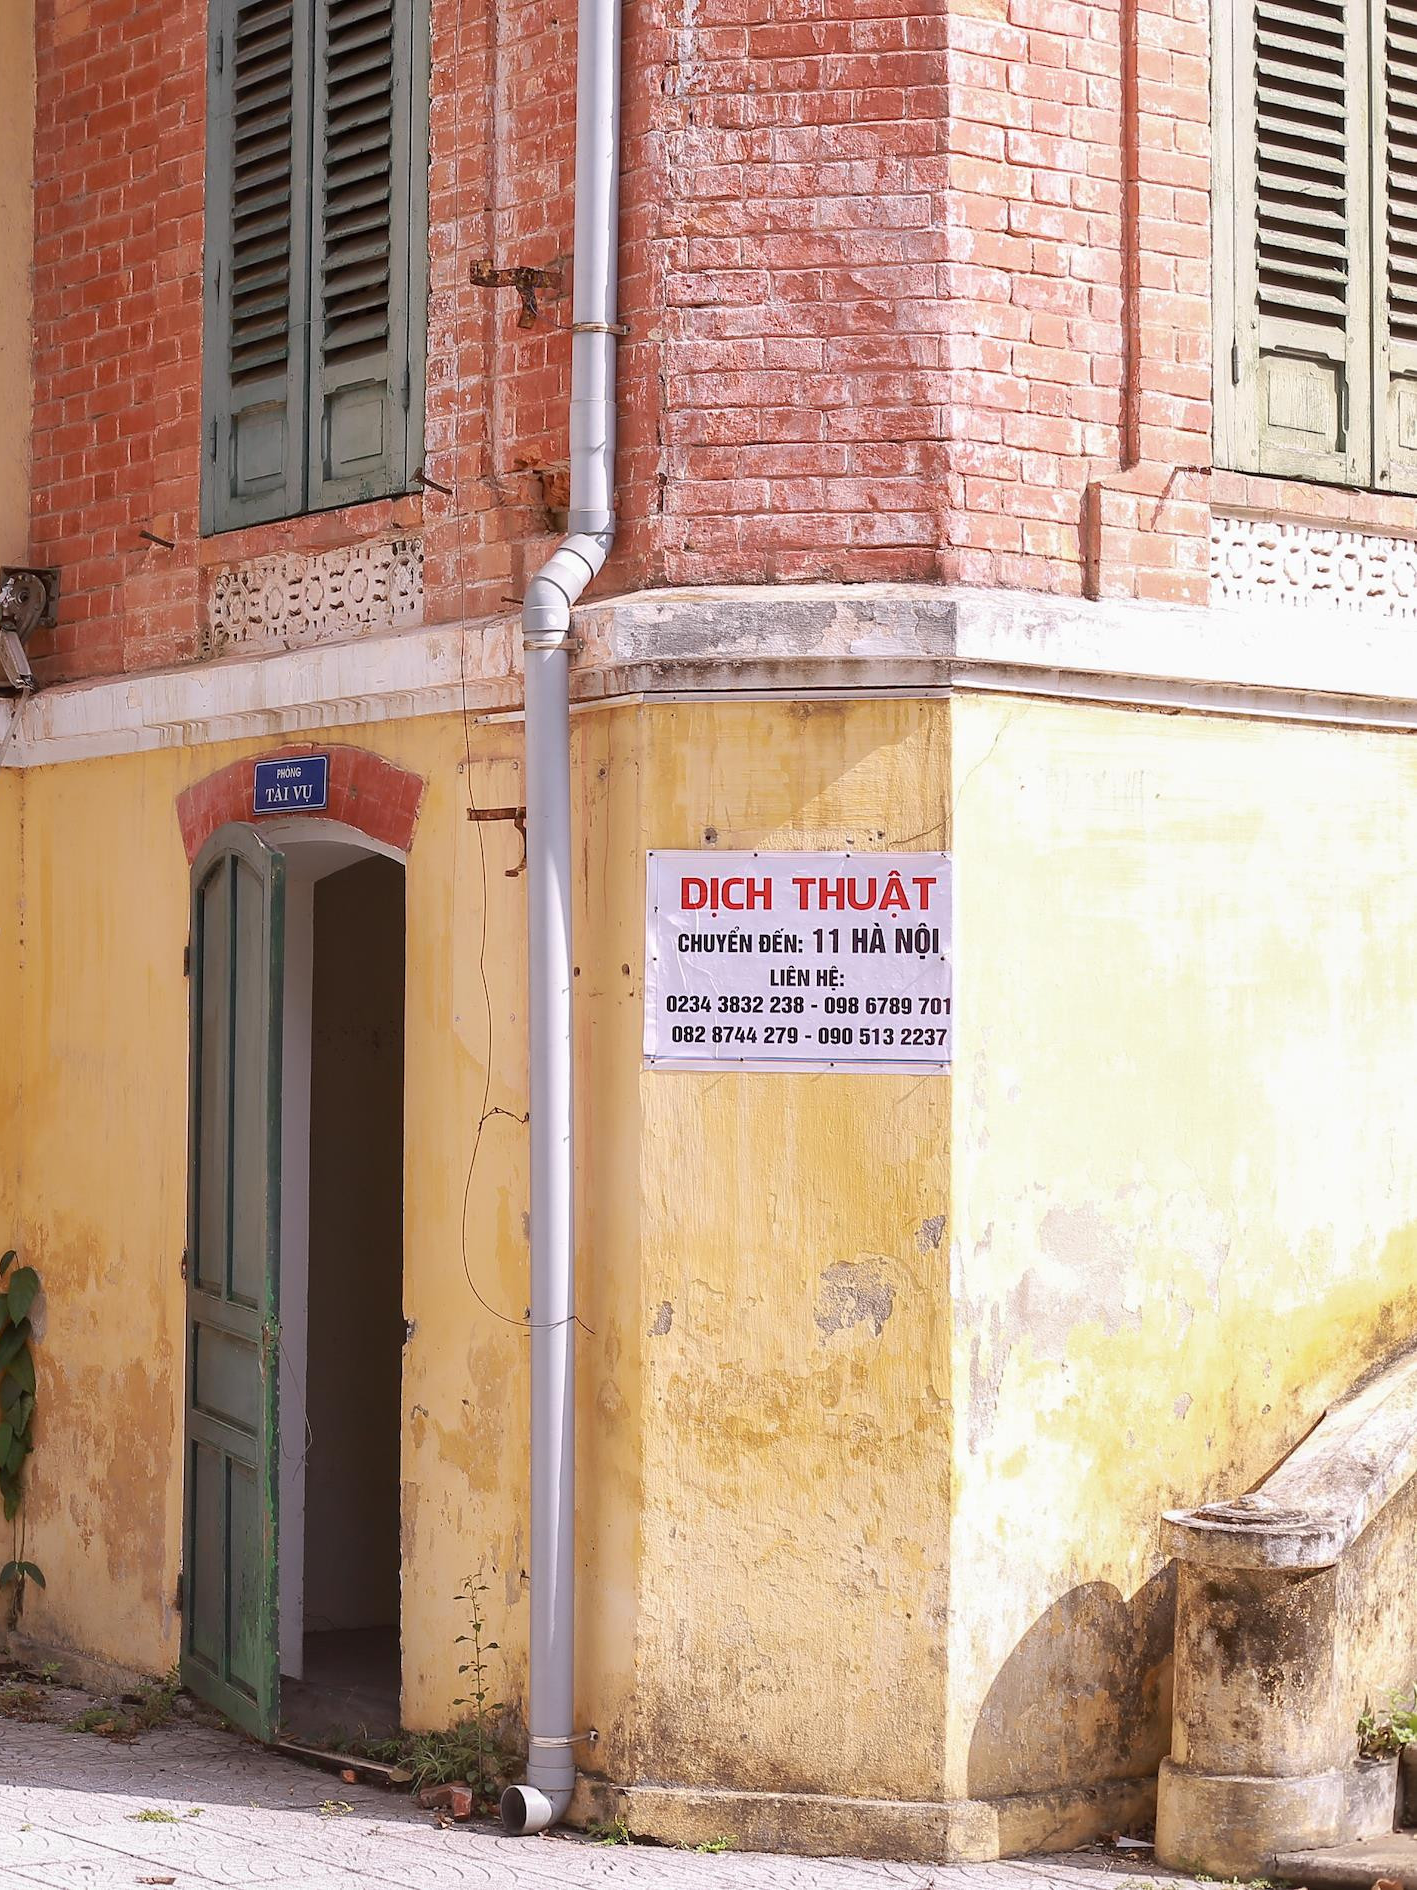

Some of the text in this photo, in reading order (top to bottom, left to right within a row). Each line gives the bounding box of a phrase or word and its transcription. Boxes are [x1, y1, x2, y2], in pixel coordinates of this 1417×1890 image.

[265, 783, 313, 803] TÀI VỤ
[680, 869, 937, 919] DỊCH THUẬT
[677, 922, 940, 960] CHUYỂN ĐẾN: 11 HÀ NỘI
[770, 965, 846, 991] LIÊN HỆ:
[666, 995, 712, 1014] 0234
[717, 995, 764, 1014] 3832
[769, 996, 805, 1014] 238
[824, 996, 859, 1015] 098
[865, 997, 913, 1015] 6789
[918, 997, 951, 1015] 701
[671, 1025, 706, 1043] 082
[711, 1026, 758, 1044] 8744
[763, 1026, 799, 1045] 279
[818, 1026, 853, 1045] 090
[859, 1027, 894, 1046] 513
[900, 1028, 948, 1046] 2237
